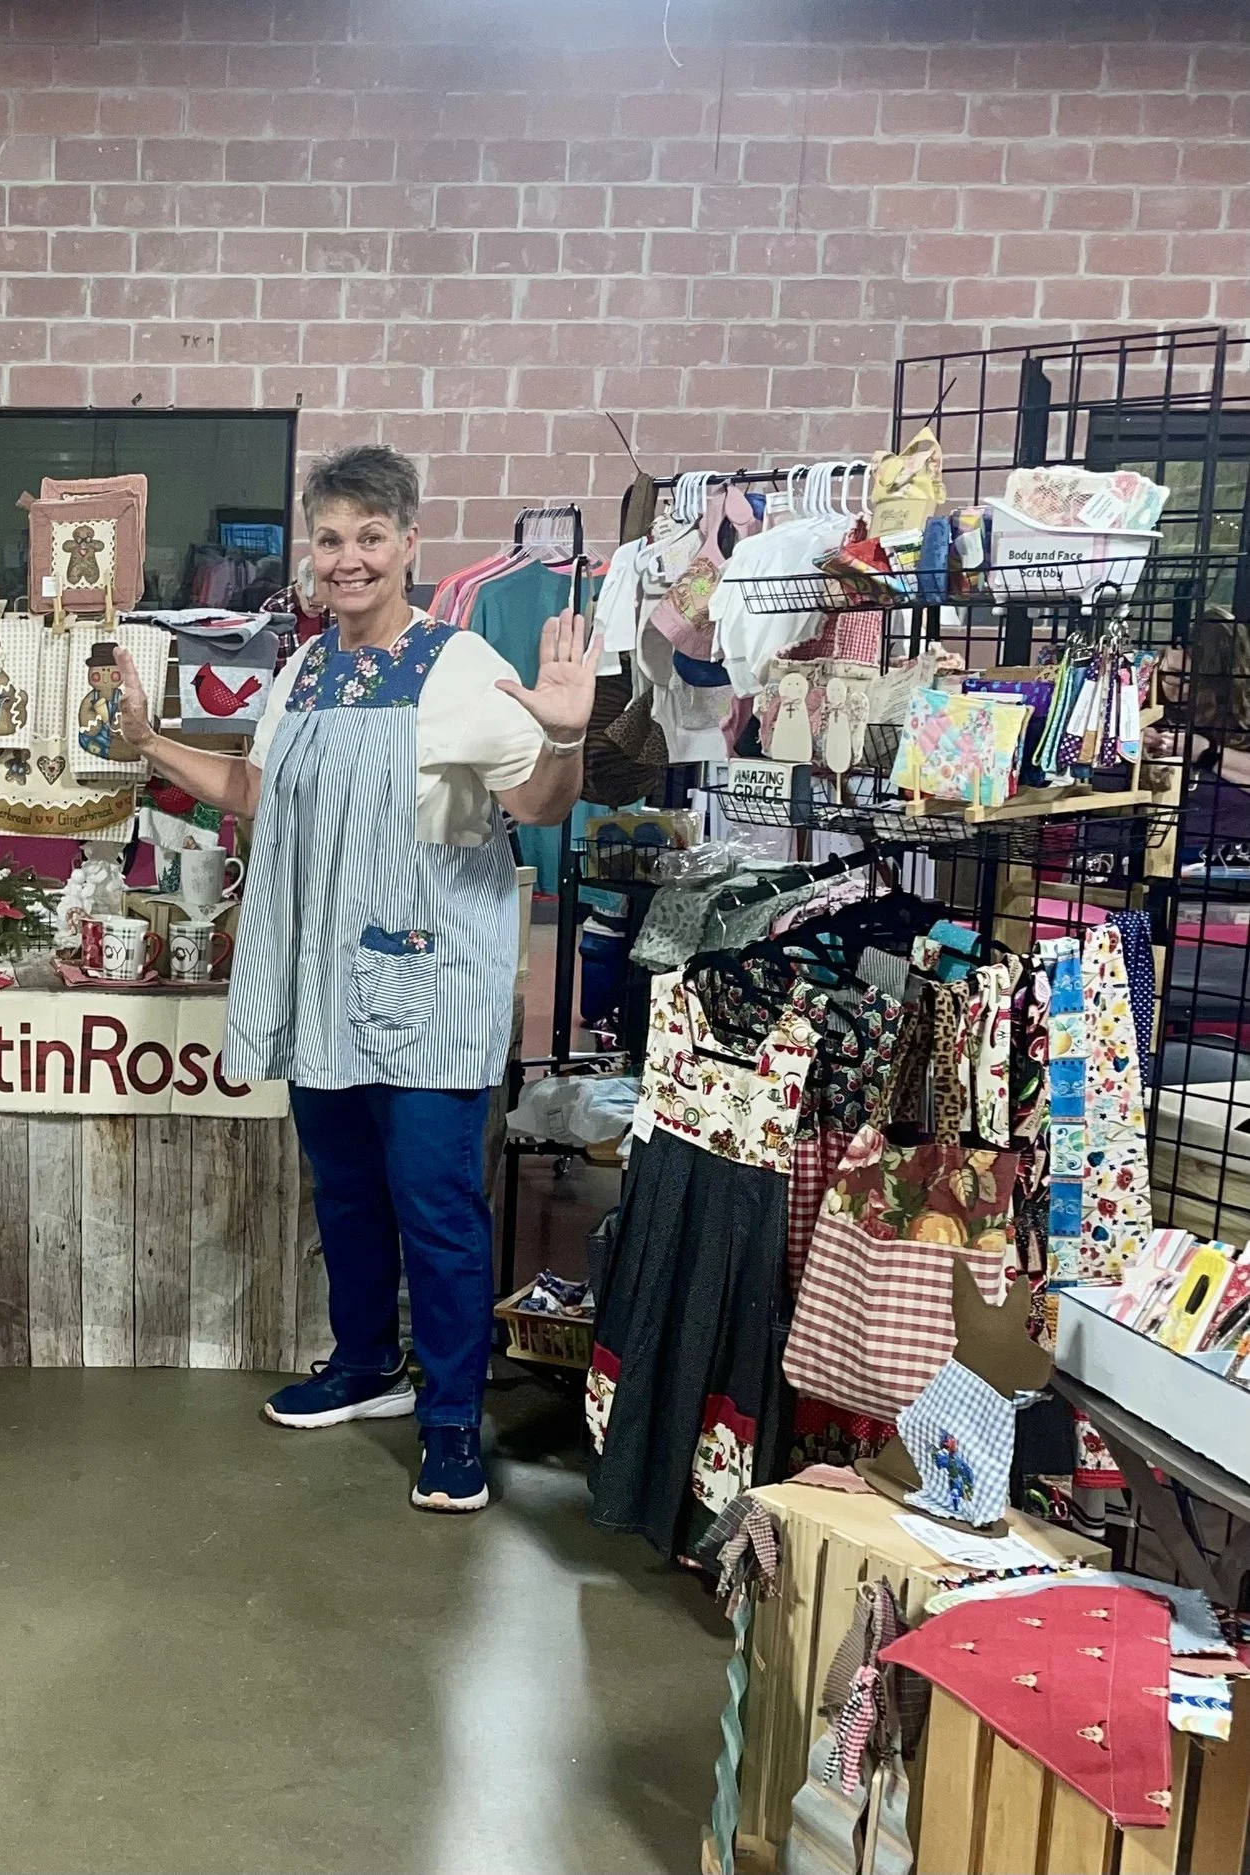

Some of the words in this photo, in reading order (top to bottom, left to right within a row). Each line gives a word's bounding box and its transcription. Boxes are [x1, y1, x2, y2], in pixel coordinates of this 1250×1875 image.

[1008, 550, 1033, 562] Body
[1035, 551, 1054, 560] and
[1057, 550, 1083, 561] Face
[733, 769, 785, 786] AMAZING
[733, 783, 784, 805] GRACE
[57, 803, 115, 828] Gingerbread
[104, 944, 123, 960] OY
